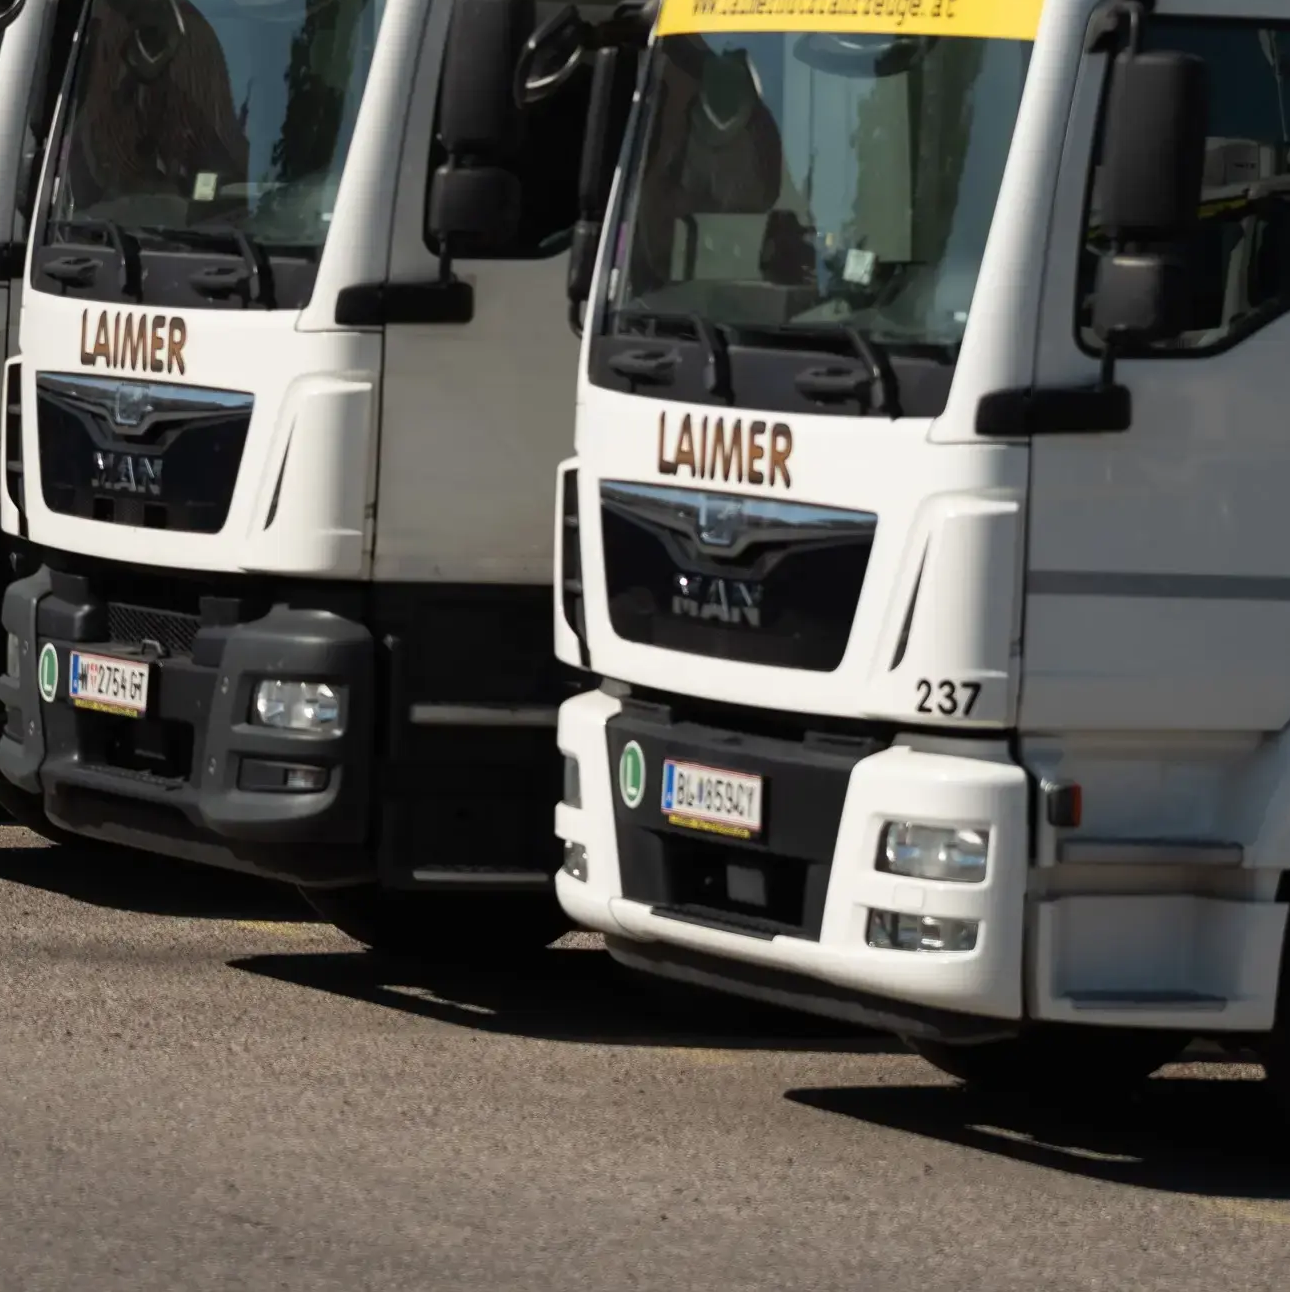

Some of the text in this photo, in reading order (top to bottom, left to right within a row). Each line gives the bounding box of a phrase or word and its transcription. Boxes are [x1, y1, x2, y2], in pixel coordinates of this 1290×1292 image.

[80, 308, 187, 376] LAIMER
[91, 451, 163, 495] MAN
[657, 410, 793, 489] LAIMER
[916, 678, 981, 718] 237
